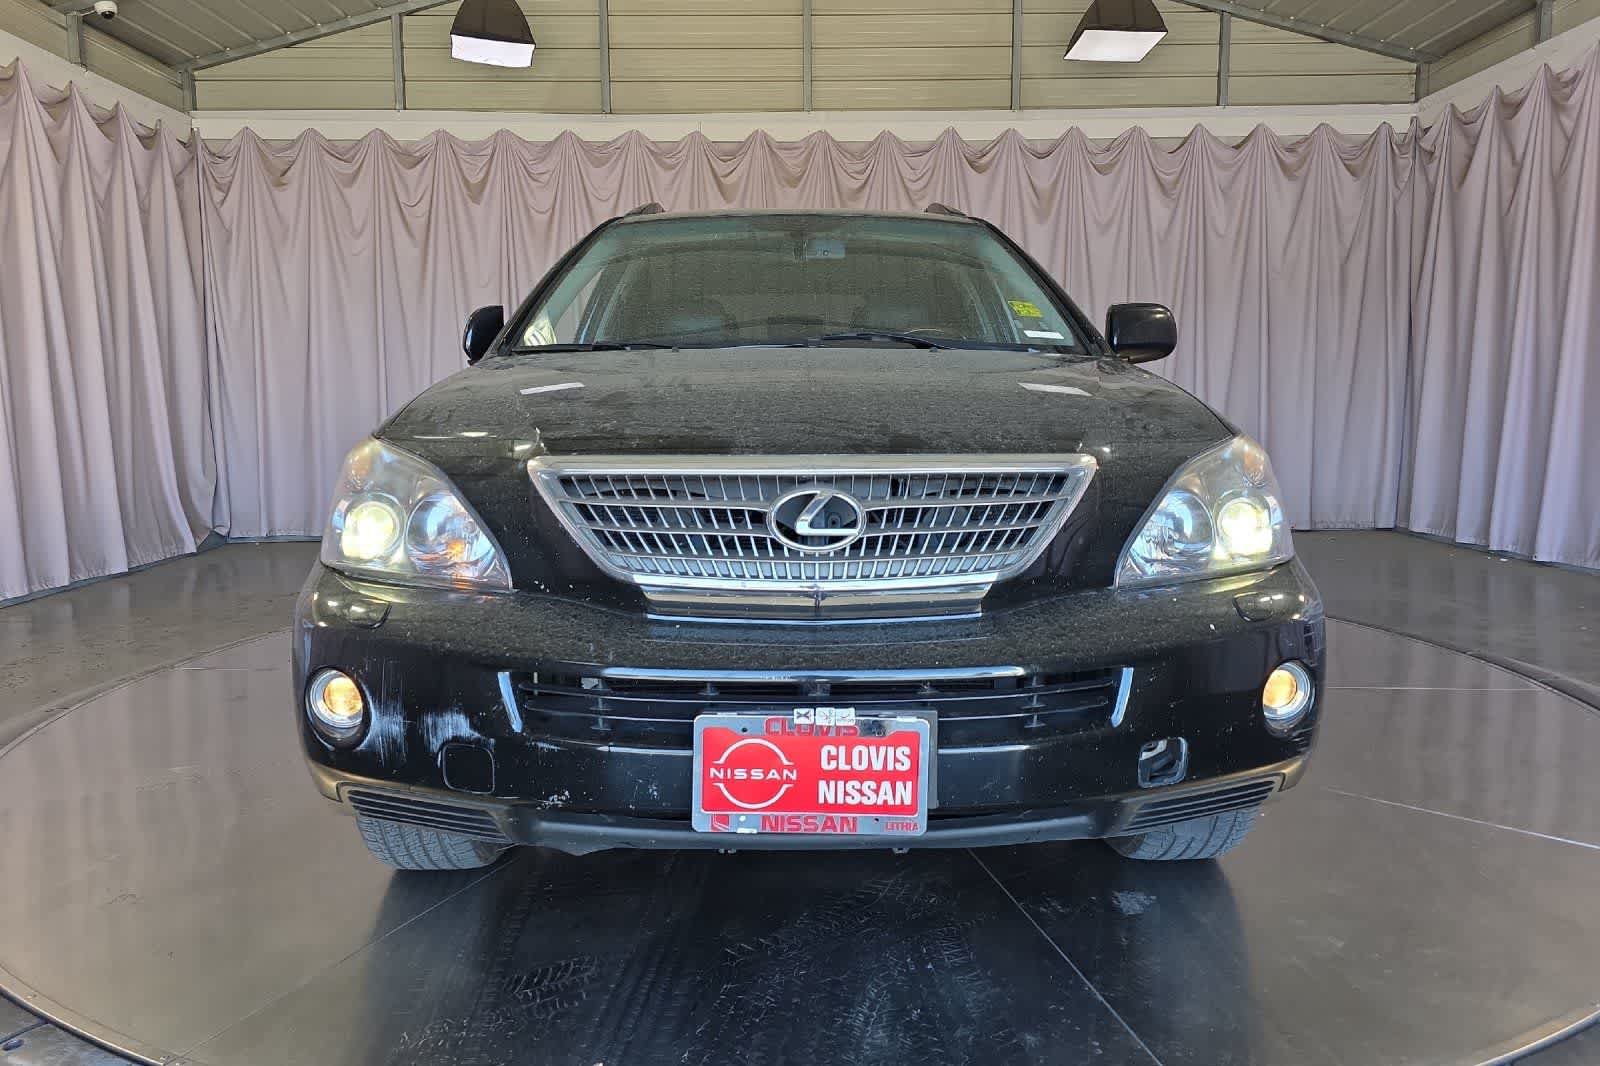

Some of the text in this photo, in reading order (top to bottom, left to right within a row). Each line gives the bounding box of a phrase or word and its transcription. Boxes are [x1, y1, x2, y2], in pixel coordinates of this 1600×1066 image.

[820, 745, 911, 771] CLOVIS
[710, 768, 797, 780] NISSAN
[818, 780, 912, 806] NISSAN
[761, 815, 858, 833] NISSAN
